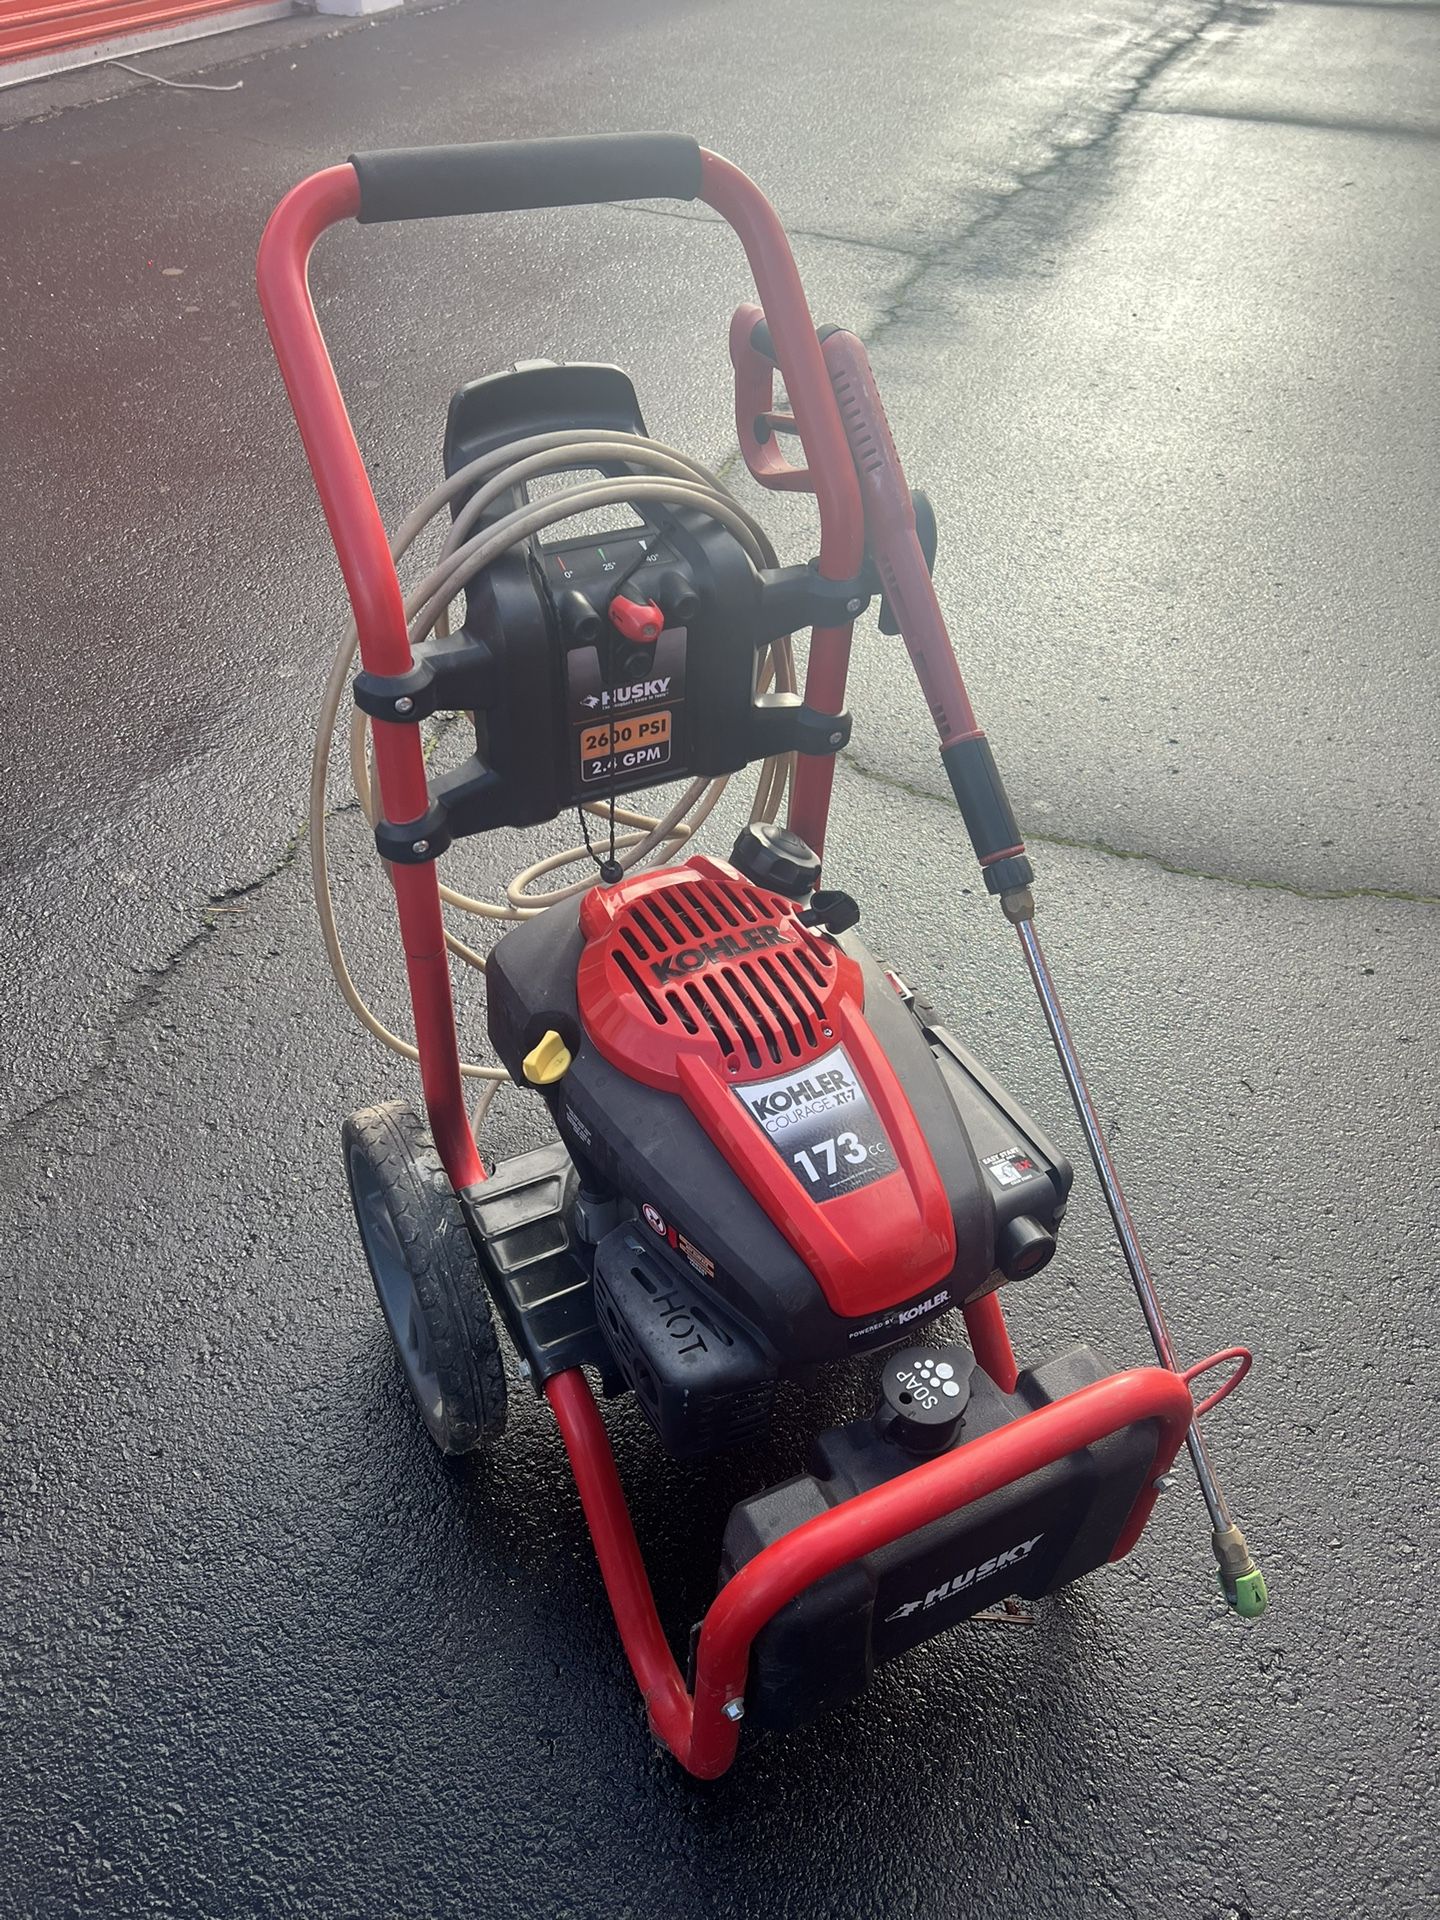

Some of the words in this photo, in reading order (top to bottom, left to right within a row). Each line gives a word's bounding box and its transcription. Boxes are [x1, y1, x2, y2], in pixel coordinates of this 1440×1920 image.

[601, 676, 671, 706] HUSKY
[585, 727, 632, 750] 2600
[638, 718, 666, 738] PSI
[622, 746, 661, 767] GPM
[650, 924, 791, 985] KOHLER
[751, 1069, 852, 1121] KOHLER
[765, 1097, 832, 1133] COURAGE
[652, 1289, 708, 1355] HOT
[848, 1322, 883, 1339] POWERED
[884, 1317, 895, 1326] BY
[898, 1290, 949, 1325] KOHLER
[896, 1371, 938, 1410] SOAP
[924, 1532, 1046, 1606] HUSKY
